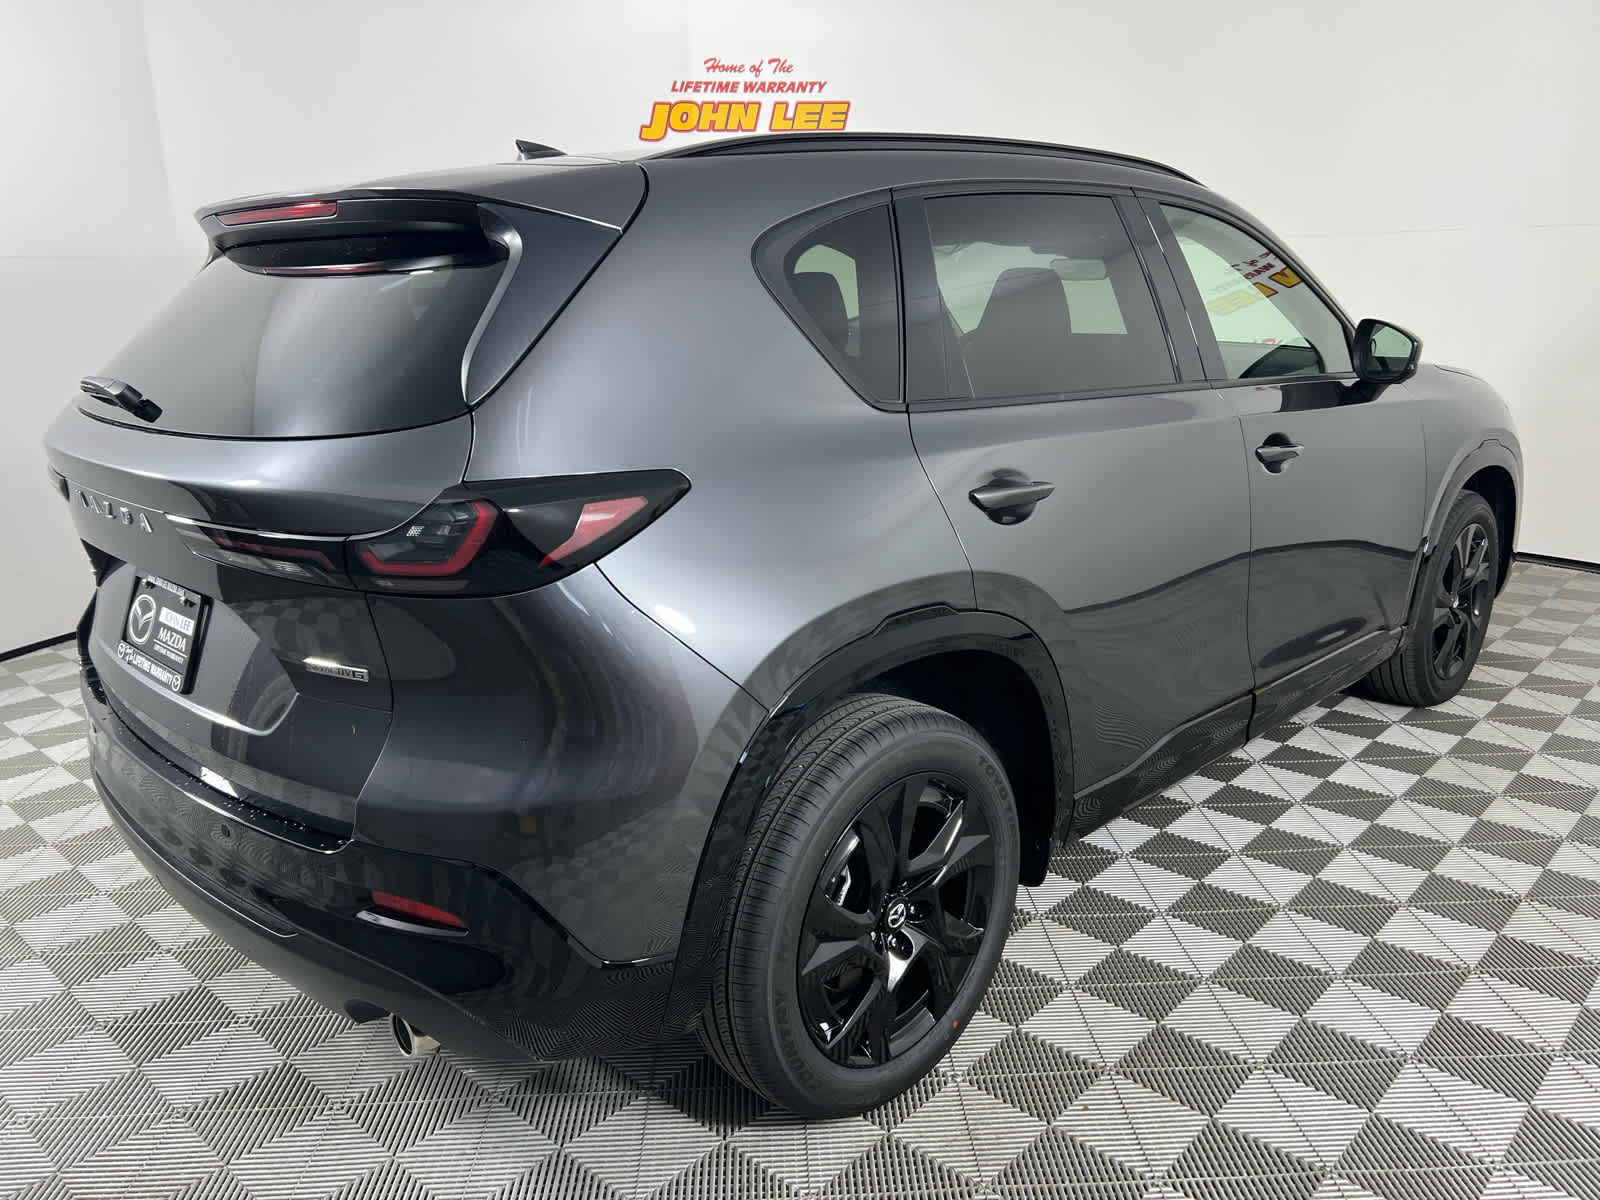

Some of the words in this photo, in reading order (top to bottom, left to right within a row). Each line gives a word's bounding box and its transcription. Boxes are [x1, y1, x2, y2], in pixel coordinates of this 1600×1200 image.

[703, 57, 745, 74] Home
[749, 58, 764, 77] of
[768, 57, 793, 74] The
[671, 80, 739, 93] LIFETIME
[743, 81, 827, 94] WARRANTY
[639, 100, 761, 142] JOHN
[769, 100, 850, 133] LEE
[157, 626, 187, 652] MAZDA
